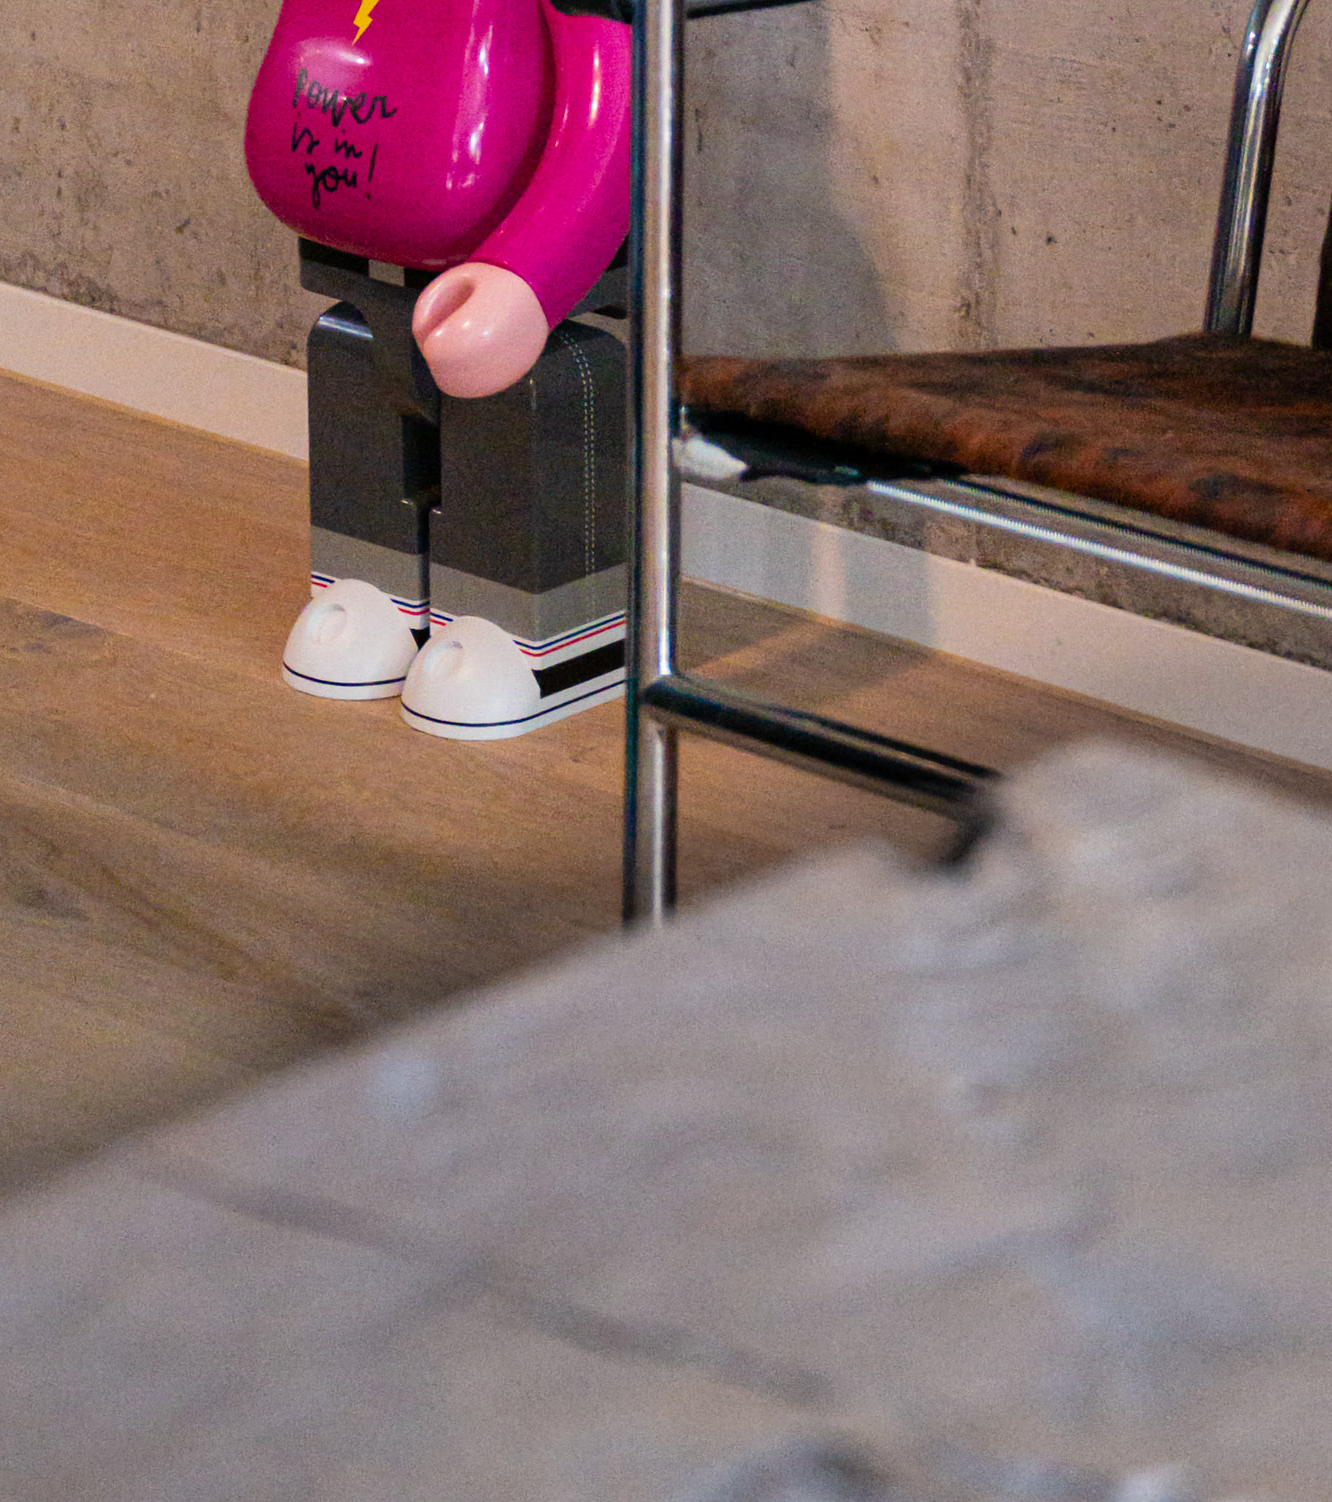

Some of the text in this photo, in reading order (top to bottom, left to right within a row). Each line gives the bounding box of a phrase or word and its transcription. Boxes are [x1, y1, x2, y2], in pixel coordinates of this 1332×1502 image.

[292, 67, 398, 127] Power
[290, 110, 363, 160] is in
